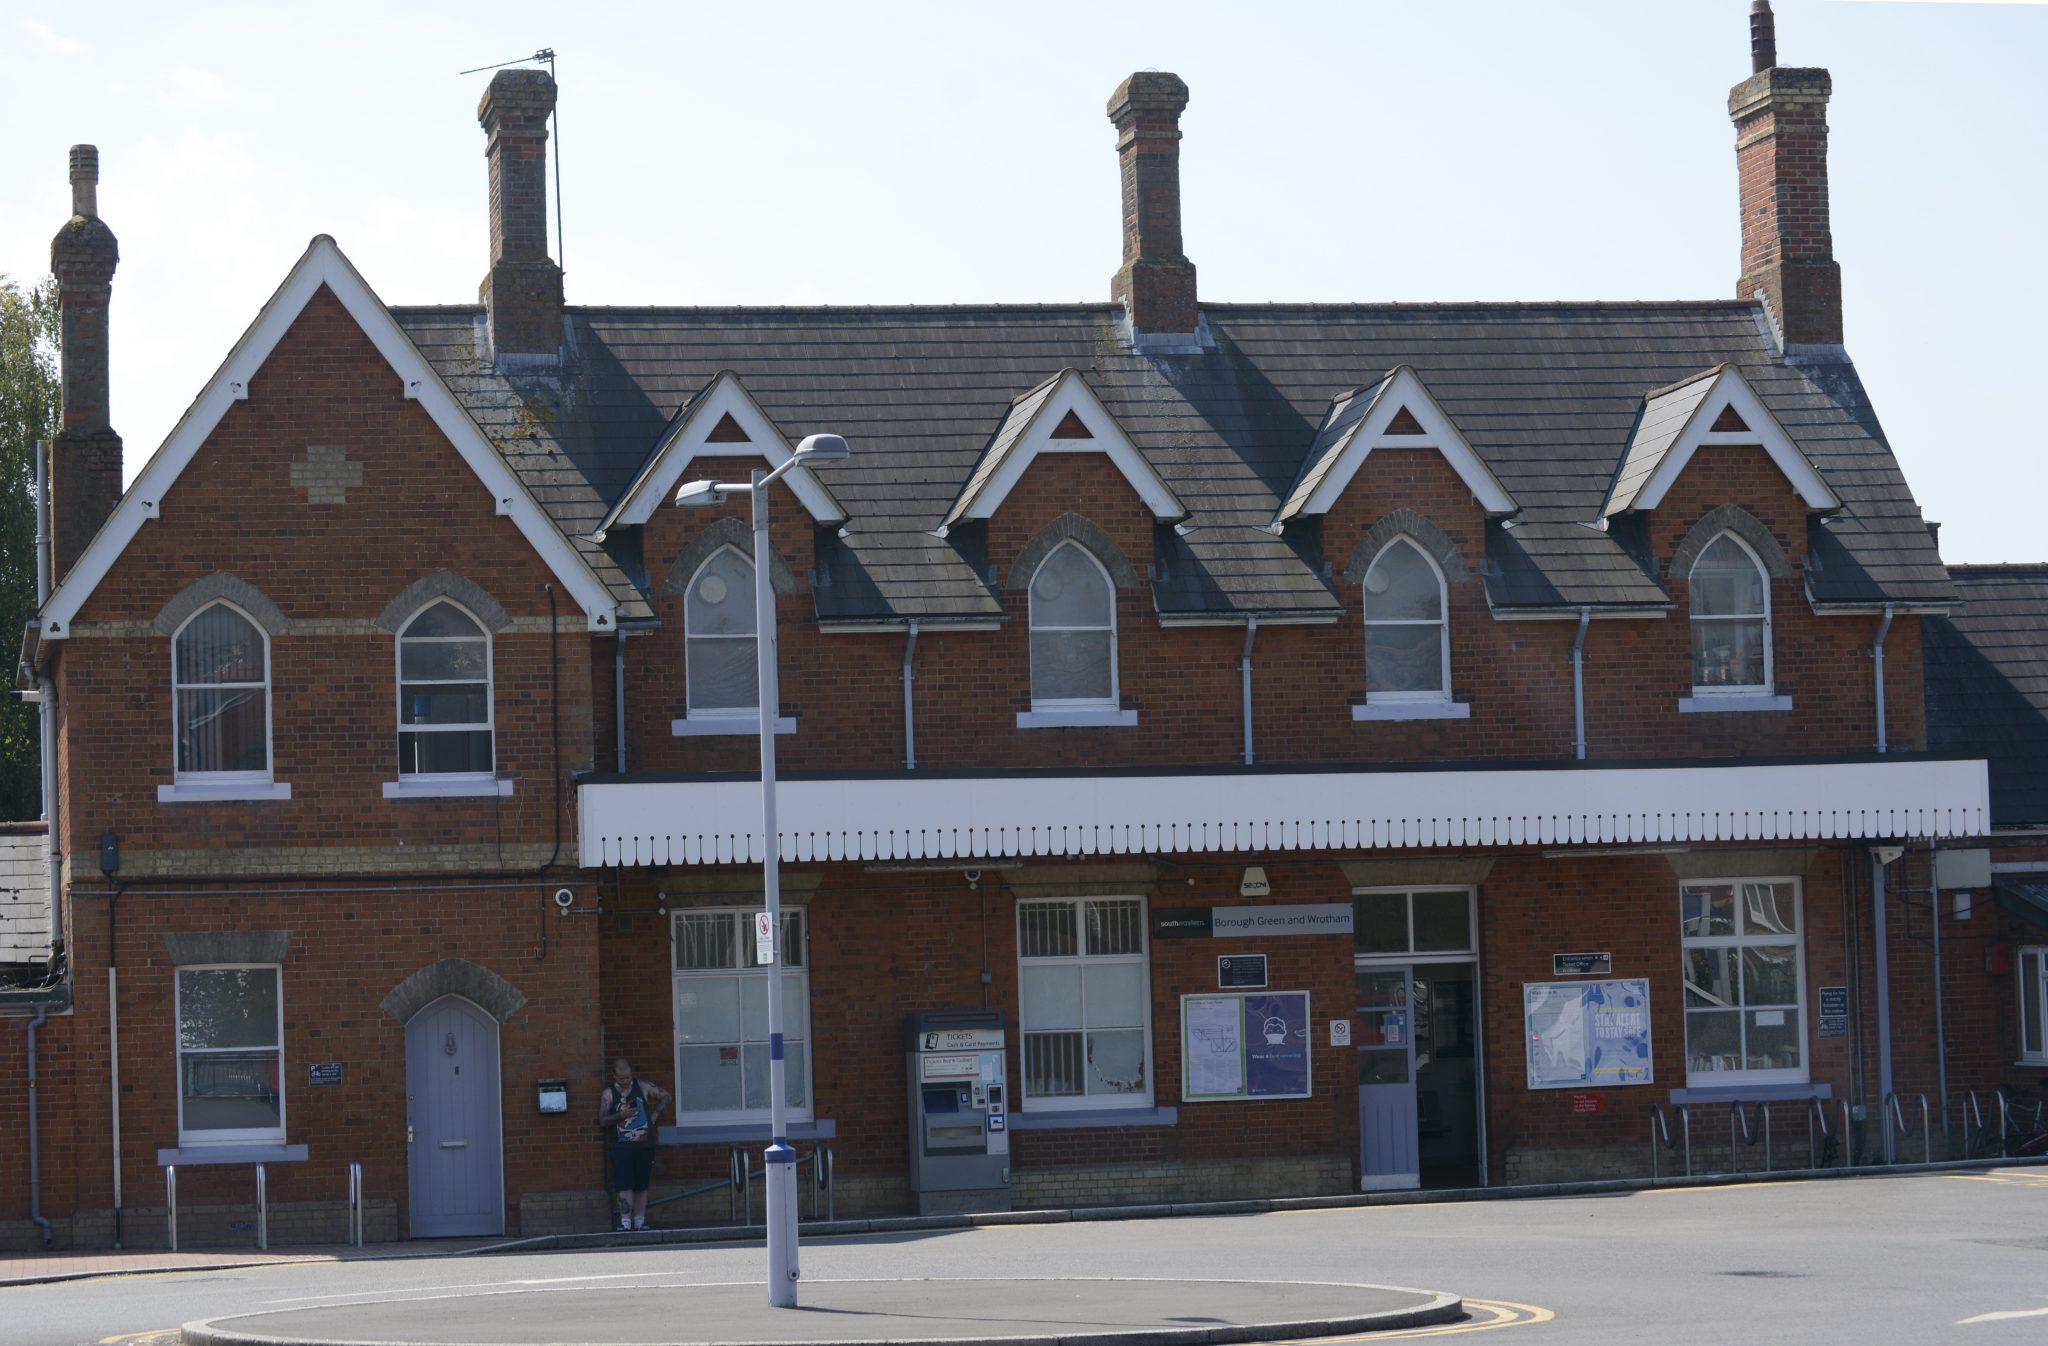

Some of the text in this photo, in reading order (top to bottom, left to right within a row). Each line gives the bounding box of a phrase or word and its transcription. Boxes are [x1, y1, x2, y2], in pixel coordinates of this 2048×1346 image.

[1243, 881, 1267, 889] SECOM
[1214, 914, 1350, 928] Borough Green and Wrotham
[1616, 1012, 1641, 1026] ALERT
[947, 1033, 973, 1041] TICKETS
[1605, 1027, 1623, 1039] STAY
[977, 1040, 1001, 1048] Payments
